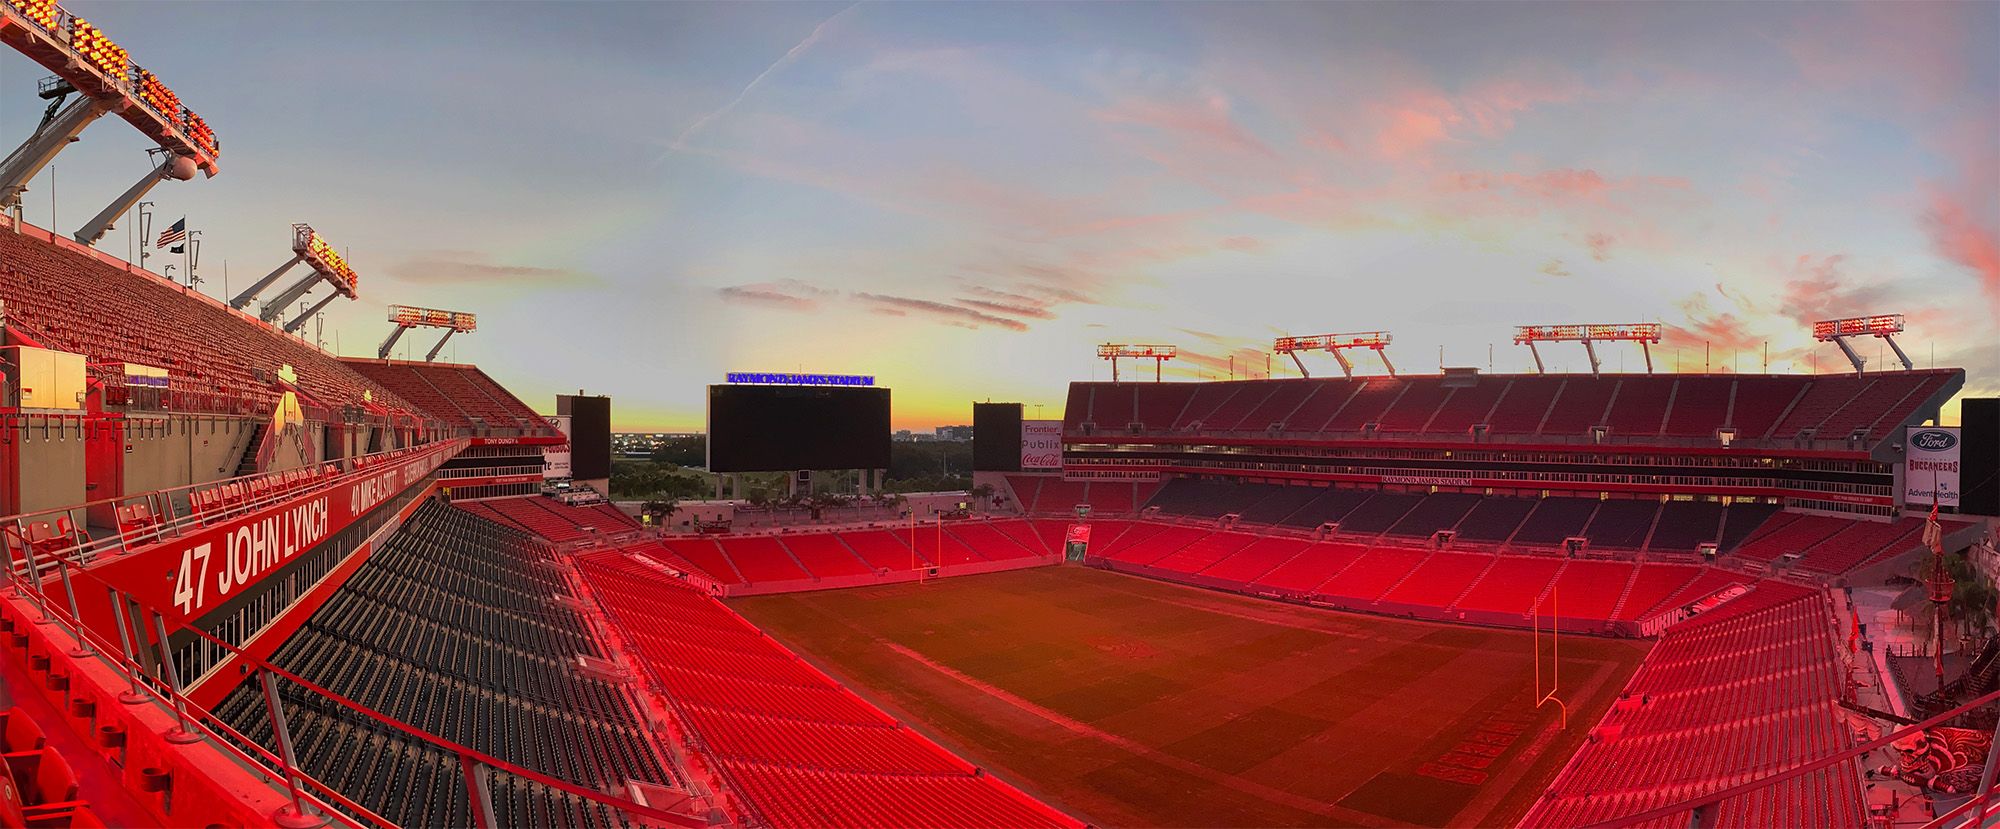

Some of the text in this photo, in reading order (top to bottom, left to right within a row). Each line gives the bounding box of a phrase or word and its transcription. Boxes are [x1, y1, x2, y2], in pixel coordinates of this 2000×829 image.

[728, 373, 874, 386] RAYMOND JAMES STADIUM
[1025, 424, 1058, 433] Frontier
[1021, 439, 1059, 449] Publix
[1919, 432, 1948, 448] Ford
[1909, 459, 1958, 473] BUCCANEERS
[1382, 476, 1471, 486] RAYMOND JAMES STADIUM
[350, 484, 360, 518] 40
[360, 477, 377, 513] MIKE
[375, 469, 398, 504] ALSTOTT
[173, 542, 212, 616] 47
[218, 515, 280, 595] JOHN
[284, 496, 328, 559] LYNCH
